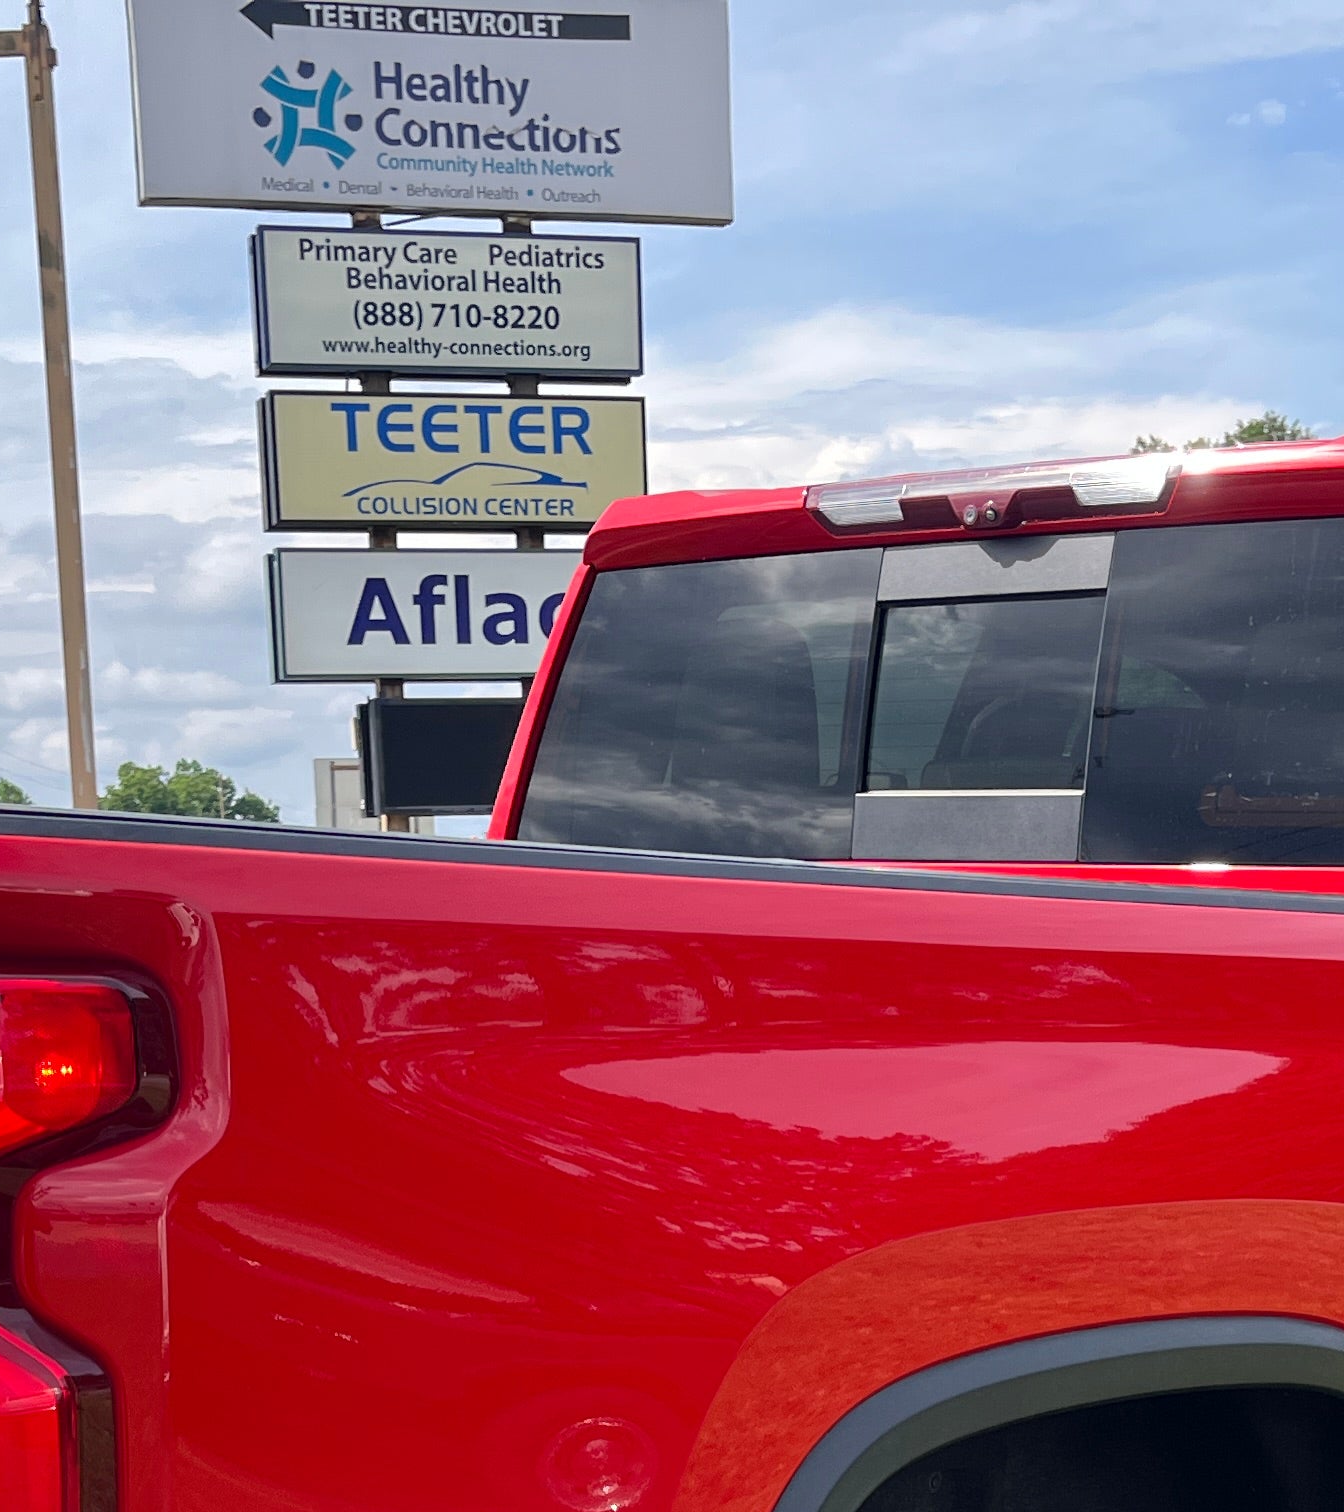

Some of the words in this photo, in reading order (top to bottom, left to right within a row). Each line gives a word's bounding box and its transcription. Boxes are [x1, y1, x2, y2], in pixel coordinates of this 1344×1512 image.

[304, 3, 403, 33] TEETER
[408, 8, 564, 38] CHEVROLET
[373, 60, 530, 115] Healthy
[375, 107, 622, 156] Connections
[376, 153, 478, 178] Community
[482, 156, 538, 177] Health
[542, 158, 615, 179] Network
[261, 176, 314, 194] Medical
[338, 178, 382, 195] Dental
[406, 182, 475, 201] Behavioral
[477, 183, 519, 201] Health
[542, 187, 602, 205] Outreach
[299, 239, 396, 267] Primary
[404, 242, 457, 265] Care
[489, 244, 606, 270] Pediatrics
[347, 267, 477, 293] Behavioral
[483, 270, 563, 295] Health
[354, 301, 423, 332] (888)
[431, 303, 560, 331] 710-8220
[323, 337, 591, 361] www.healthy-connections.org
[330, 402, 593, 456] TEETER
[357, 496, 478, 516] COLLISION
[484, 497, 575, 517] CENTER
